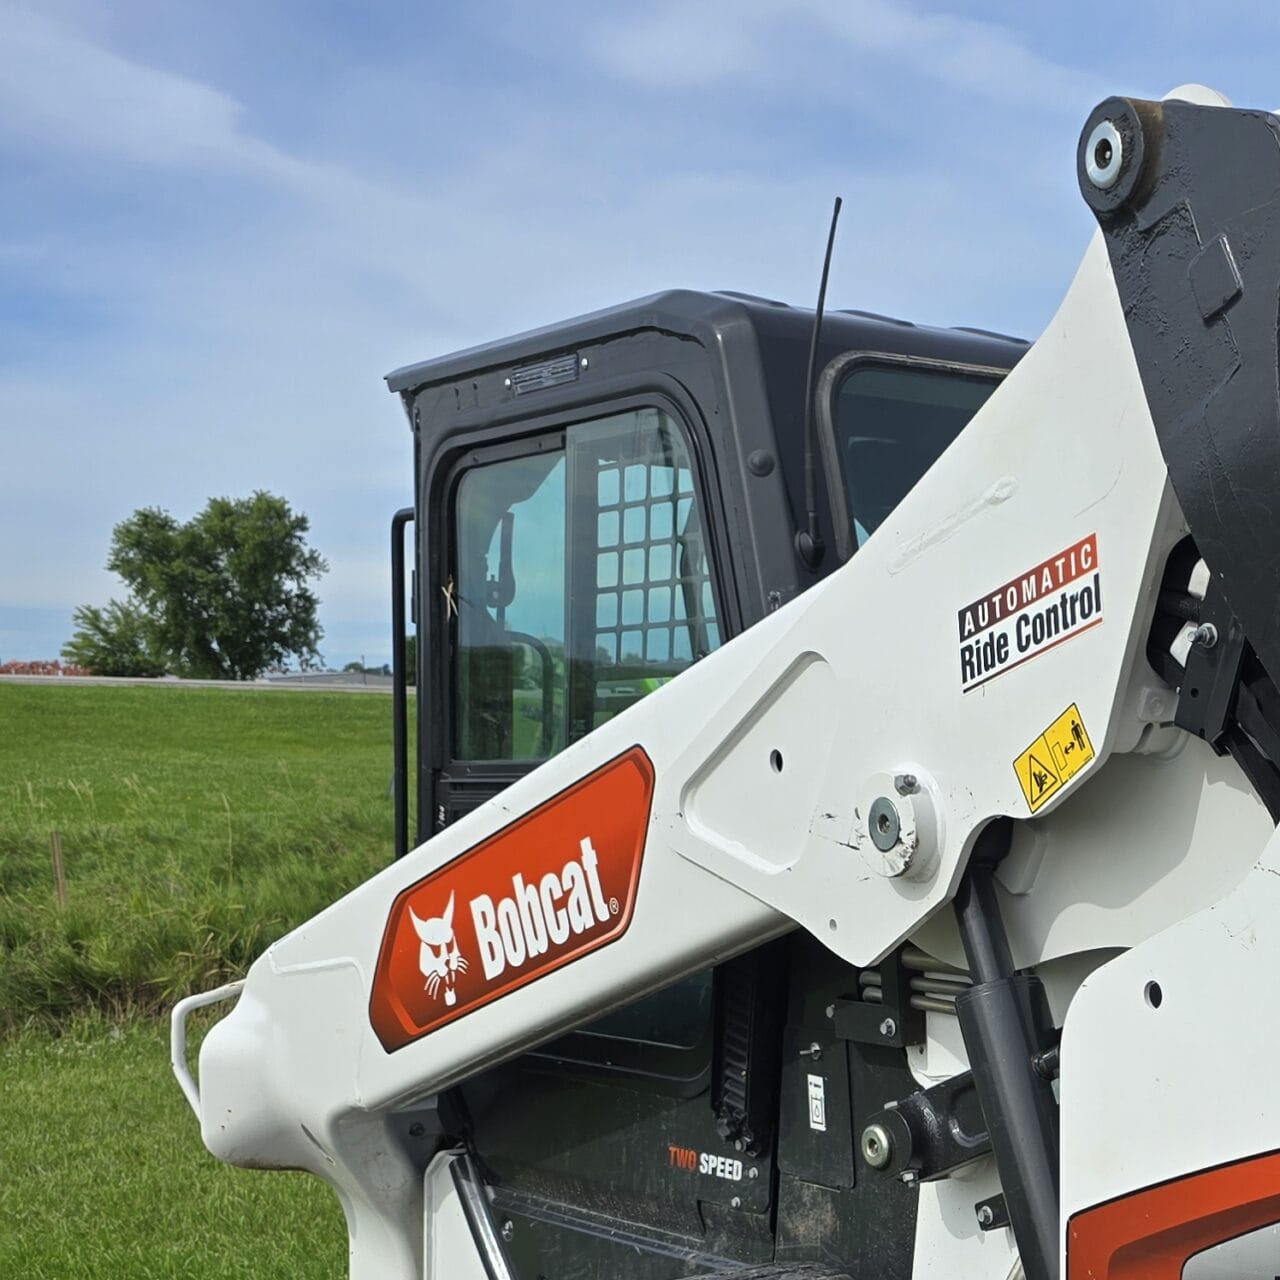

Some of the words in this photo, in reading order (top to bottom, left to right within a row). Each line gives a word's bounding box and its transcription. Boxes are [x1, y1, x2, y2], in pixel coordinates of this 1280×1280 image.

[960, 631, 1010, 684] Ride
[1015, 572, 1102, 654] Control
[963, 542, 1093, 637] AUTOMATIC
[469, 836, 611, 981] Bobcat
[668, 1146, 697, 1170] TWO
[699, 1152, 743, 1181] SPEED
